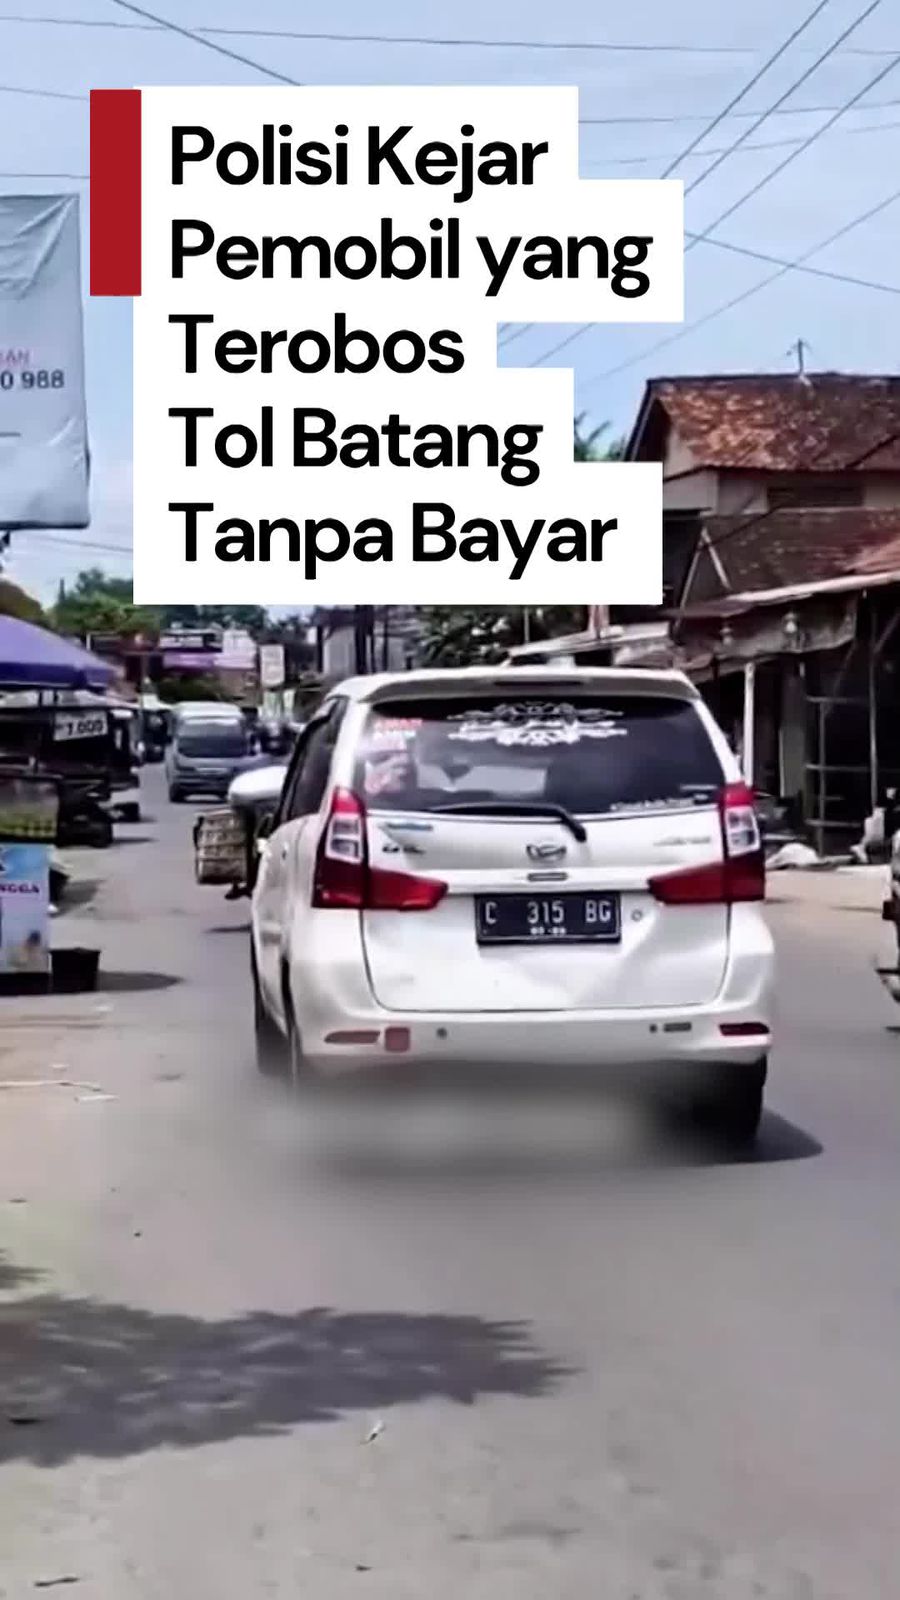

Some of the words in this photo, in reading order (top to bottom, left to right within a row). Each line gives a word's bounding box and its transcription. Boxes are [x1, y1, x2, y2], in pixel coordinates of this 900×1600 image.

[21, 368, 64, 390] 988
[485, 901, 497, 924] C
[527, 900, 564, 924] 315
[585, 900, 611, 923] BG
